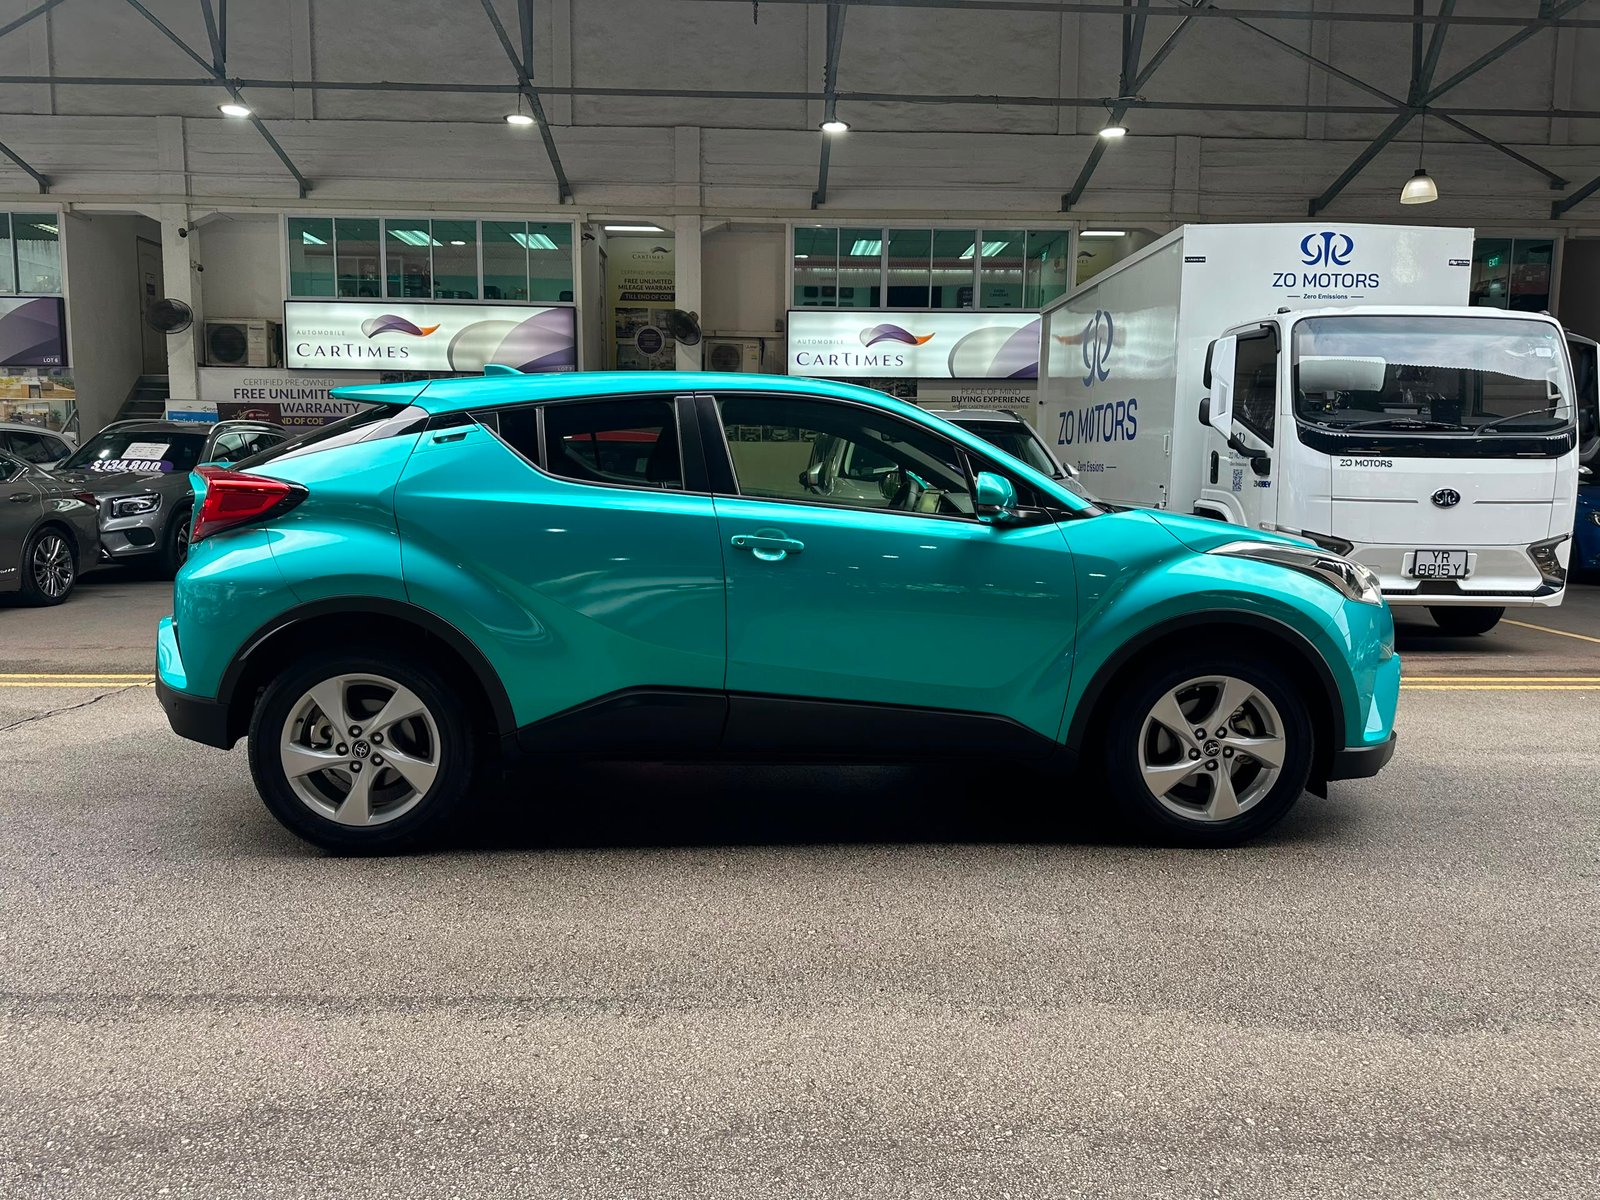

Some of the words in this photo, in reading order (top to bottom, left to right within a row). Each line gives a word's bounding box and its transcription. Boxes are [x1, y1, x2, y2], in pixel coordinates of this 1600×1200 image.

[1272, 273, 1297, 288] ZO
[1303, 273, 1380, 288] MOTORS
[243, 378, 283, 387] CERTIFIED
[285, 378, 335, 388] PRE-OWNED
[233, 388, 266, 399] FREE
[269, 388, 335, 400] UNLIMITE
[961, 387, 985, 395] PEACE
[986, 387, 998, 396] OF
[1000, 388, 1021, 396] MIND
[951, 395, 982, 403] BUYING
[983, 396, 1031, 404] EXPERIENCE
[281, 403, 361, 414] WARRANTY
[293, 417, 306, 425] OF
[307, 417, 324, 426] COE
[1057, 410, 1075, 446] ZO
[1077, 398, 1138, 445] MOTORS
[1339, 458, 1353, 468] ZO
[1354, 459, 1393, 468] MOTORS
[1431, 551, 1451, 564] YR
